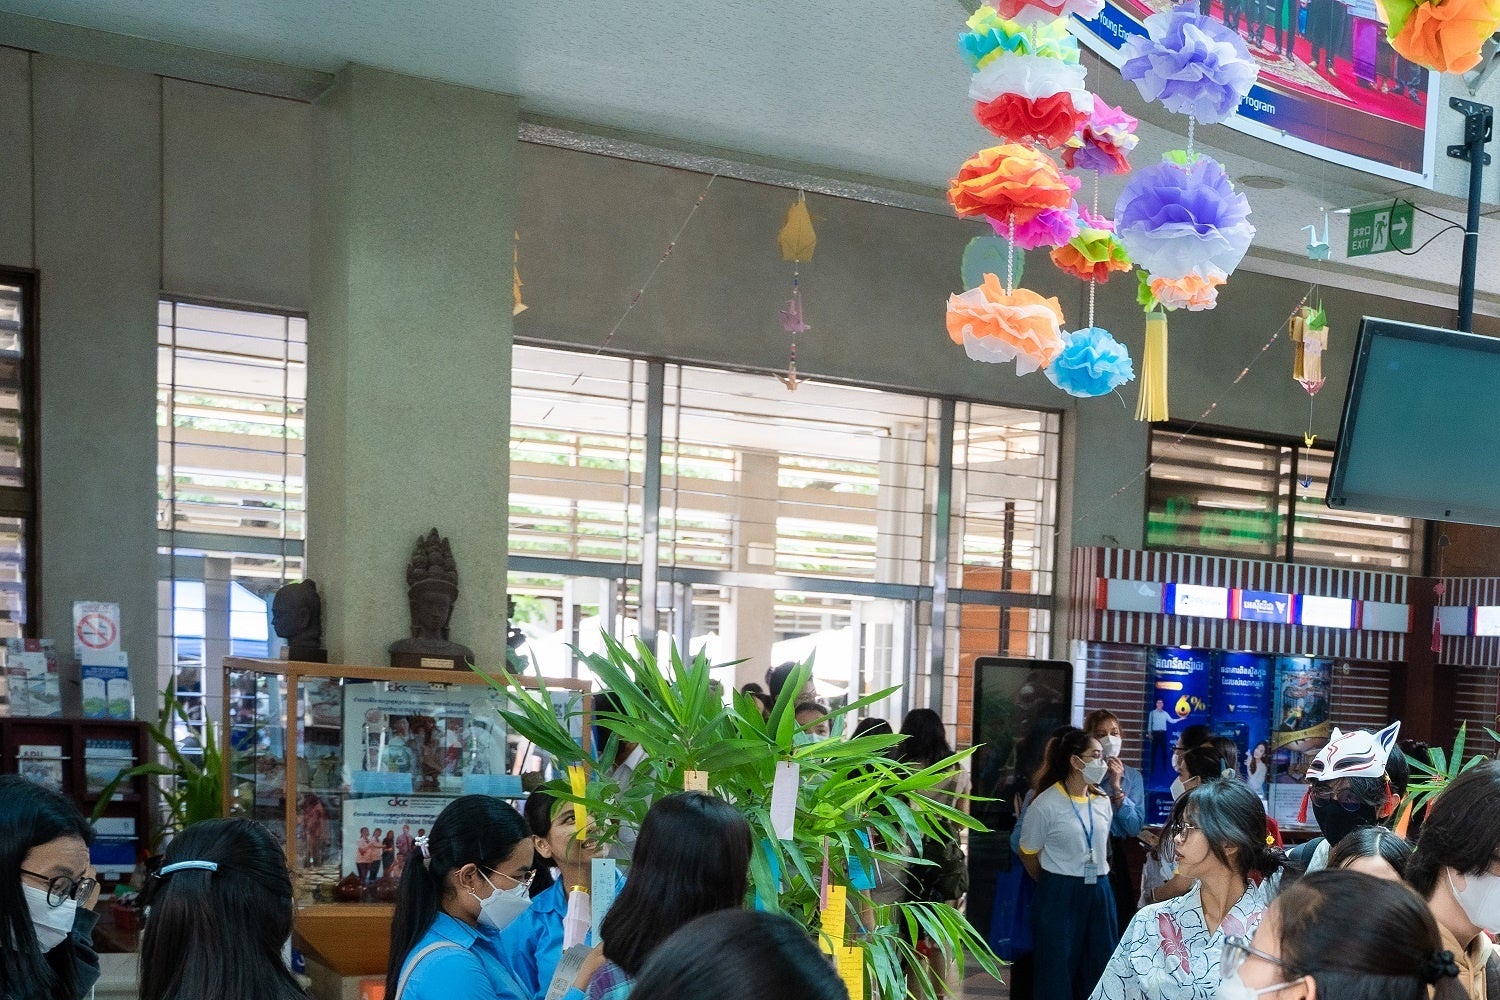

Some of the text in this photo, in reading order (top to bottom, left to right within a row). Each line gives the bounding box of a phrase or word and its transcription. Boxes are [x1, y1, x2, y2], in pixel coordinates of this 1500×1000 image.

[1100, 13, 1119, 36] Young
[1352, 238, 1370, 250] EXIT
[1174, 694, 1206, 717] 6%
